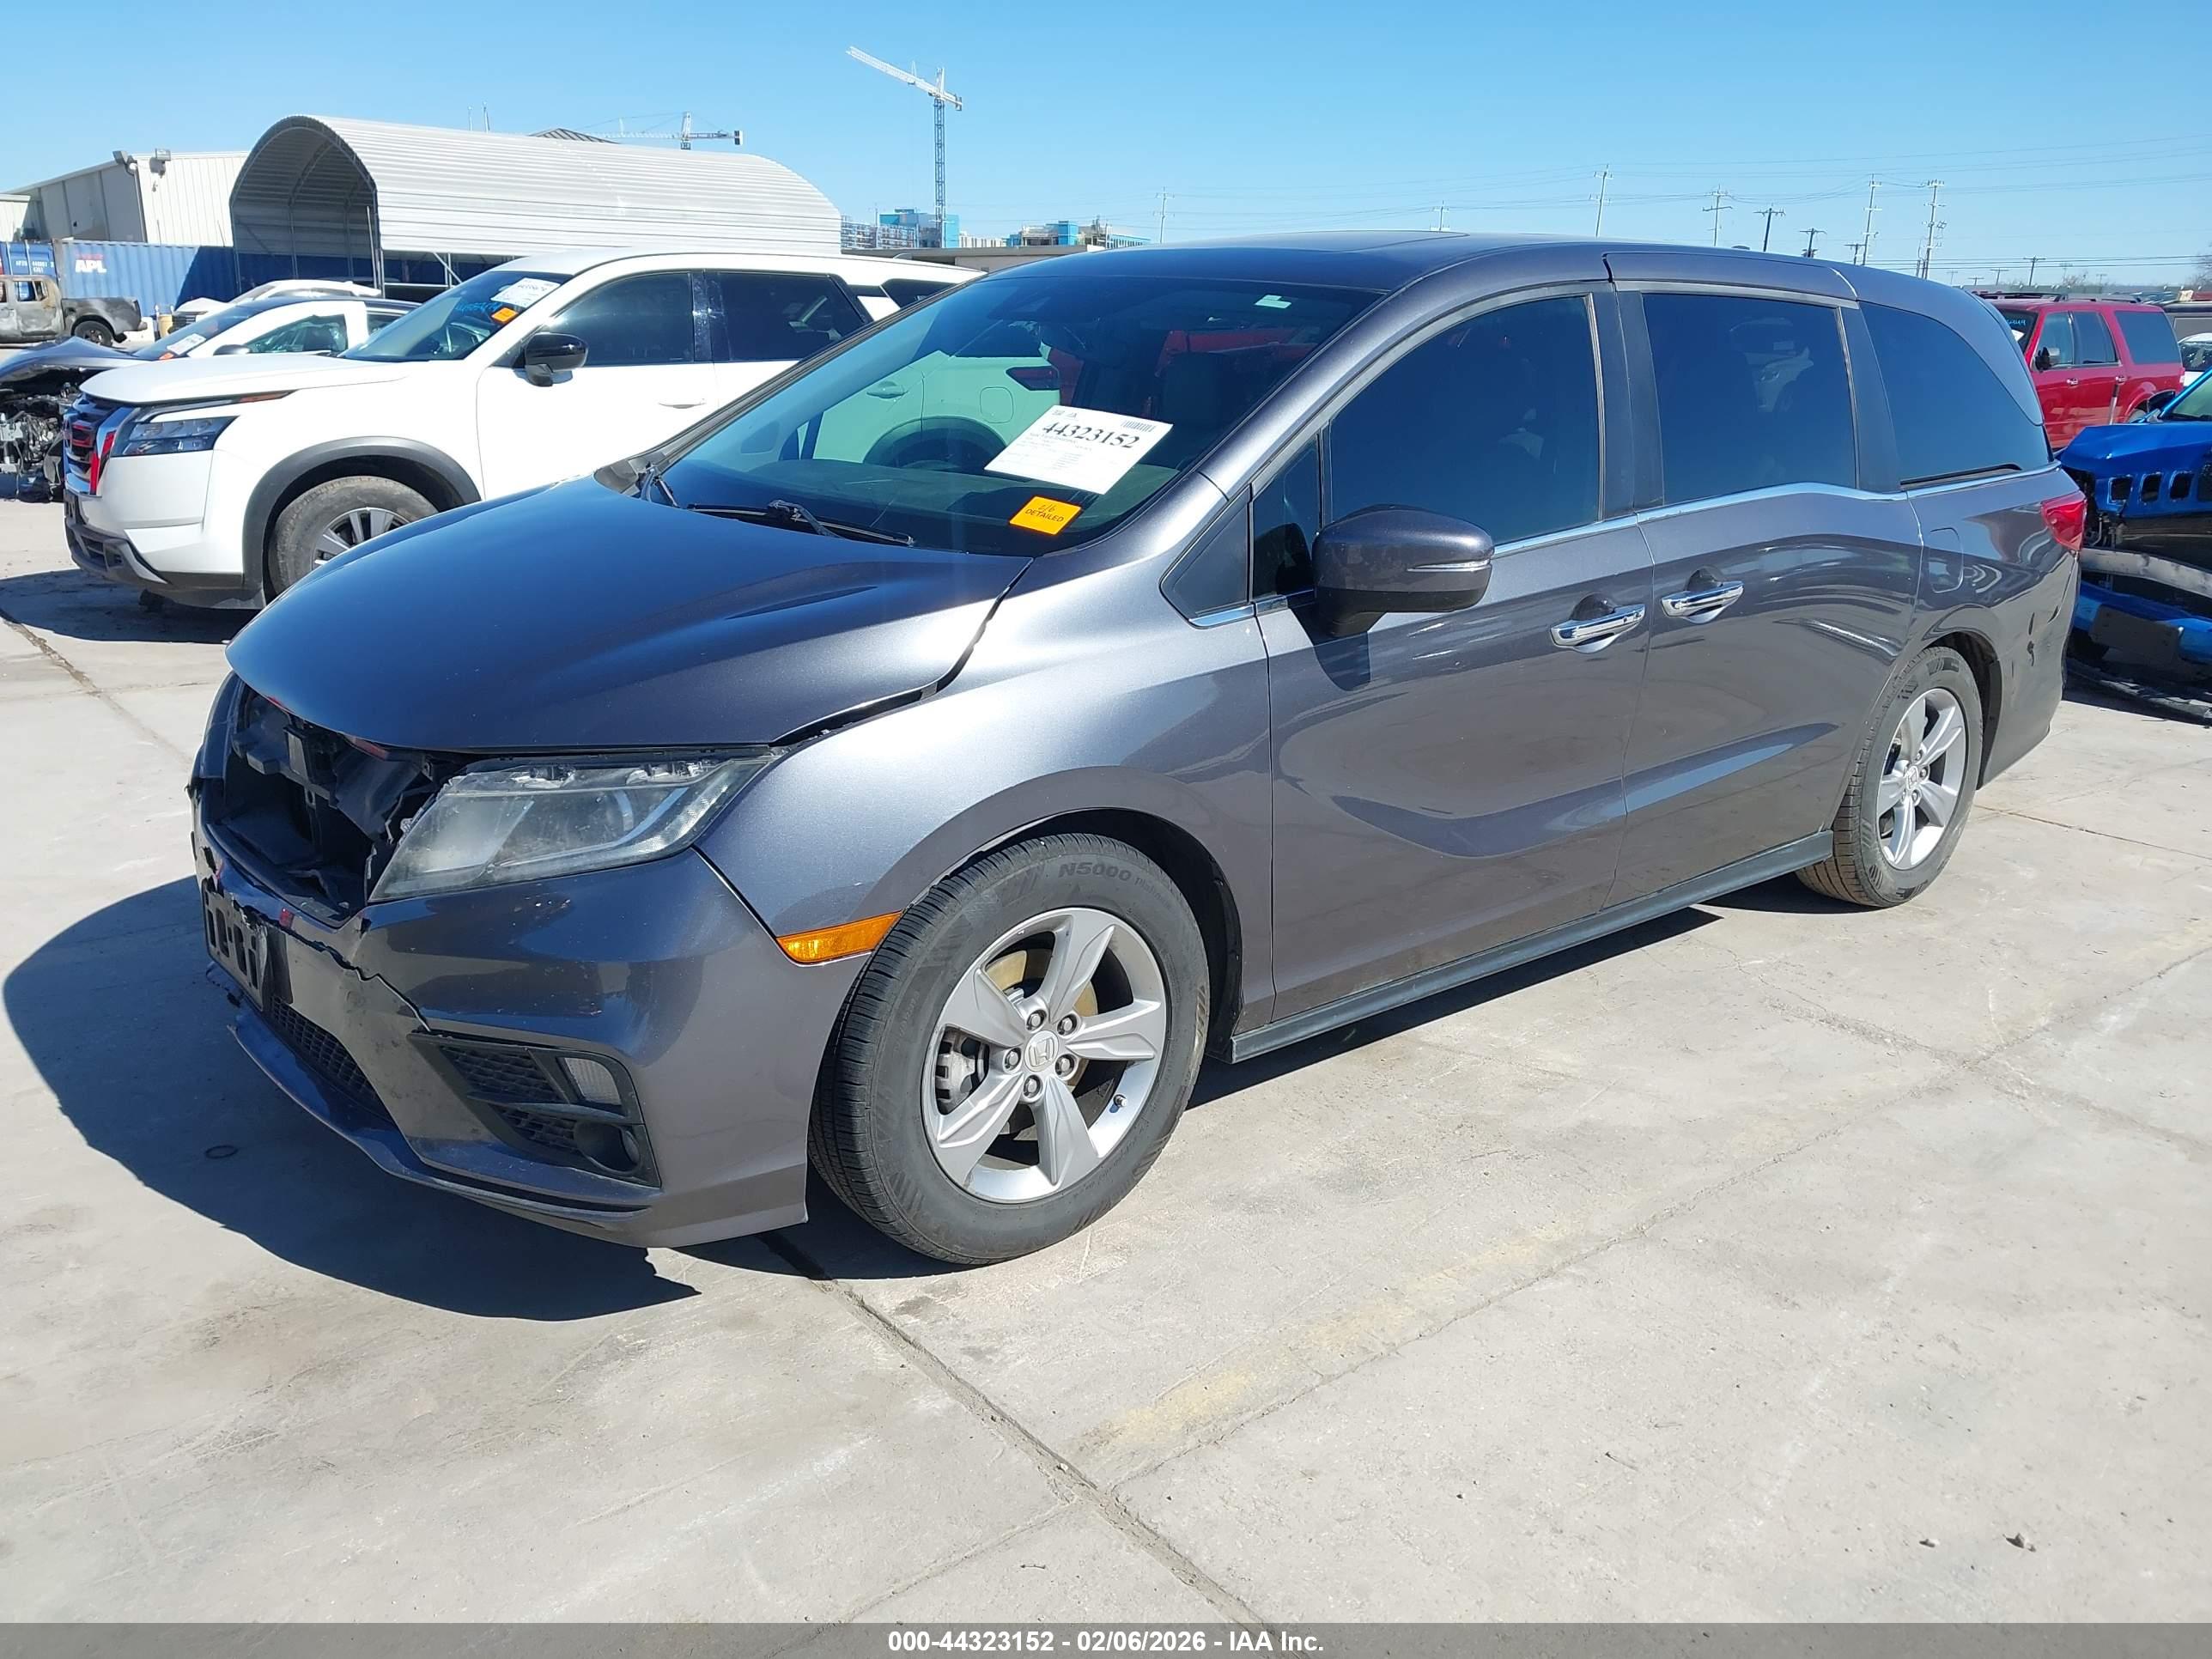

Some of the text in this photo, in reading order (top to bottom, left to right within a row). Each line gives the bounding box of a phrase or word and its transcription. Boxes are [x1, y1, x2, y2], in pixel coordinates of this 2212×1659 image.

[75, 259, 107, 273] APL
[1042, 422, 1140, 448] 44323152
[1024, 508, 1065, 523] DETAILED
[1059, 862, 1132, 881] N5000
